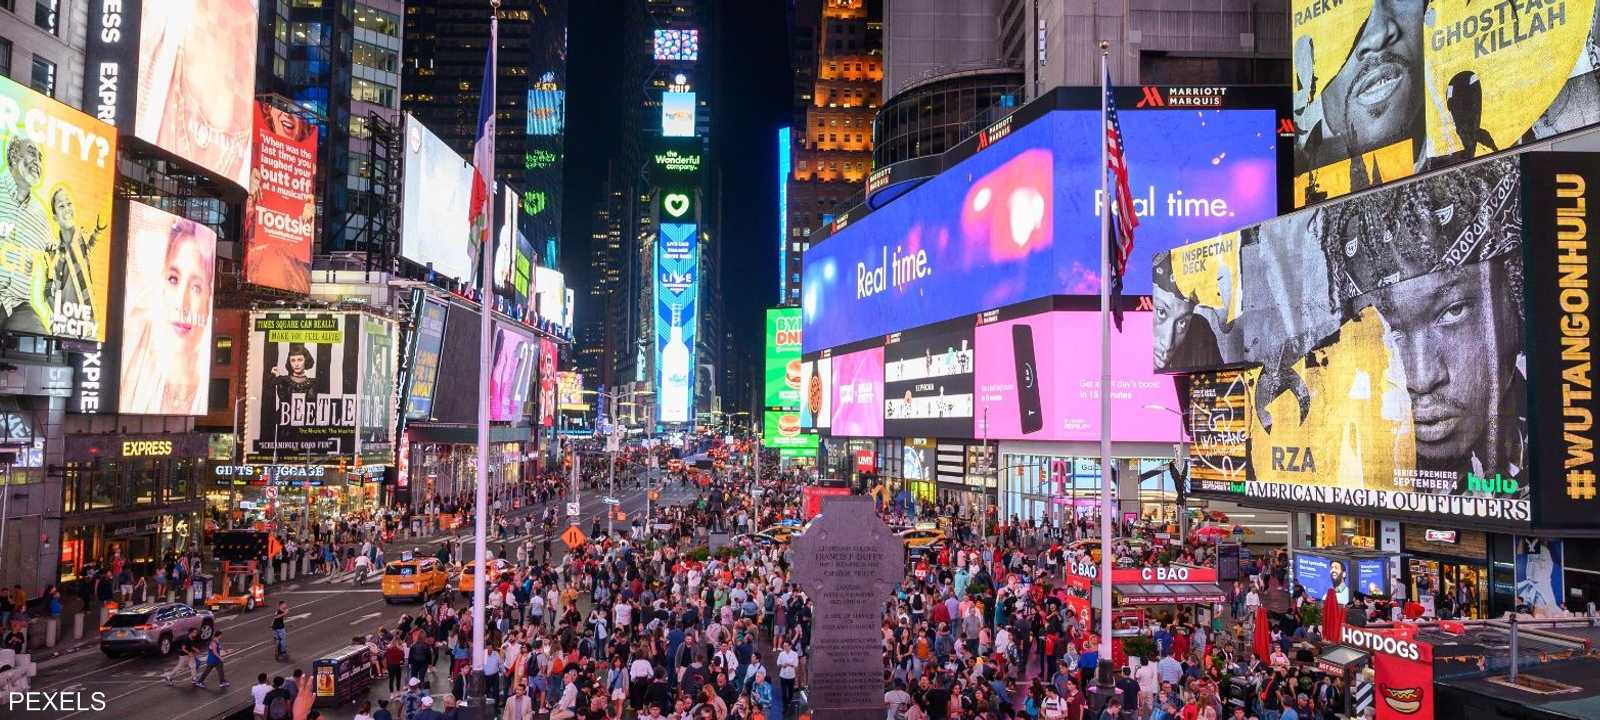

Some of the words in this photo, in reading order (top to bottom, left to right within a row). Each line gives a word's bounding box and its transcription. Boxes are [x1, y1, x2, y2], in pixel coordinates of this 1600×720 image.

[1474, 2, 1566, 58] KILLAH
[98, 62, 119, 126] EXPR
[668, 84, 690, 93] 2019
[1169, 87, 1227, 95] MARRIOTT
[1169, 97, 1220, 105] MARQUIS
[989, 115, 1013, 134] MARRIOTT
[25, 107, 110, 168] CITY?
[261, 143, 276, 156] last
[279, 150, 296, 163] time
[298, 157, 312, 168] you
[286, 144, 300, 155] was
[300, 149, 312, 160] the
[655, 155, 700, 165] Wonderful
[261, 154, 293, 171] laughed
[294, 166, 311, 177] your
[260, 164, 290, 187] butt
[291, 177, 312, 193] off
[1168, 190, 1235, 217] time.
[256, 205, 312, 236] Tootsie
[1182, 239, 1233, 261] INSPECTAH
[857, 248, 887, 300] Real
[892, 248, 932, 287] time.
[1183, 259, 1207, 275] DECK
[53, 289, 92, 321] LOVE
[66, 319, 97, 338] CITY
[257, 319, 275, 329] TIMES
[276, 319, 298, 330] SQUARE
[300, 319, 313, 329] CAN
[314, 319, 337, 329] REALLY
[271, 332, 288, 341] MAKE
[305, 332, 320, 341] FEEL
[1556, 173, 1596, 499] #WUTANGONHULU
[80, 342, 102, 413] XPRE
[122, 440, 173, 457] EXPRESS
[300, 441, 316, 449] GOOD
[1201, 430, 1248, 450] WU-TANG
[1271, 446, 1317, 474] RZA
[1394, 469, 1418, 478] SERIES
[1419, 470, 1458, 479] PREMIERE
[1394, 478, 1449, 489] SEPTEMBER
[1450, 481, 1458, 490] 4
[1466, 472, 1518, 494] hulu
[1246, 480, 1327, 503] AMERICAN
[1333, 487, 1389, 508] EAGLE
[1392, 491, 1530, 521] OUTFITTERS
[1071, 562, 1077, 574] C
[1078, 563, 1097, 579] BAO
[1142, 567, 1152, 580] C
[1157, 567, 1188, 580] BAO
[1342, 627, 1419, 660] HOTDOGS
